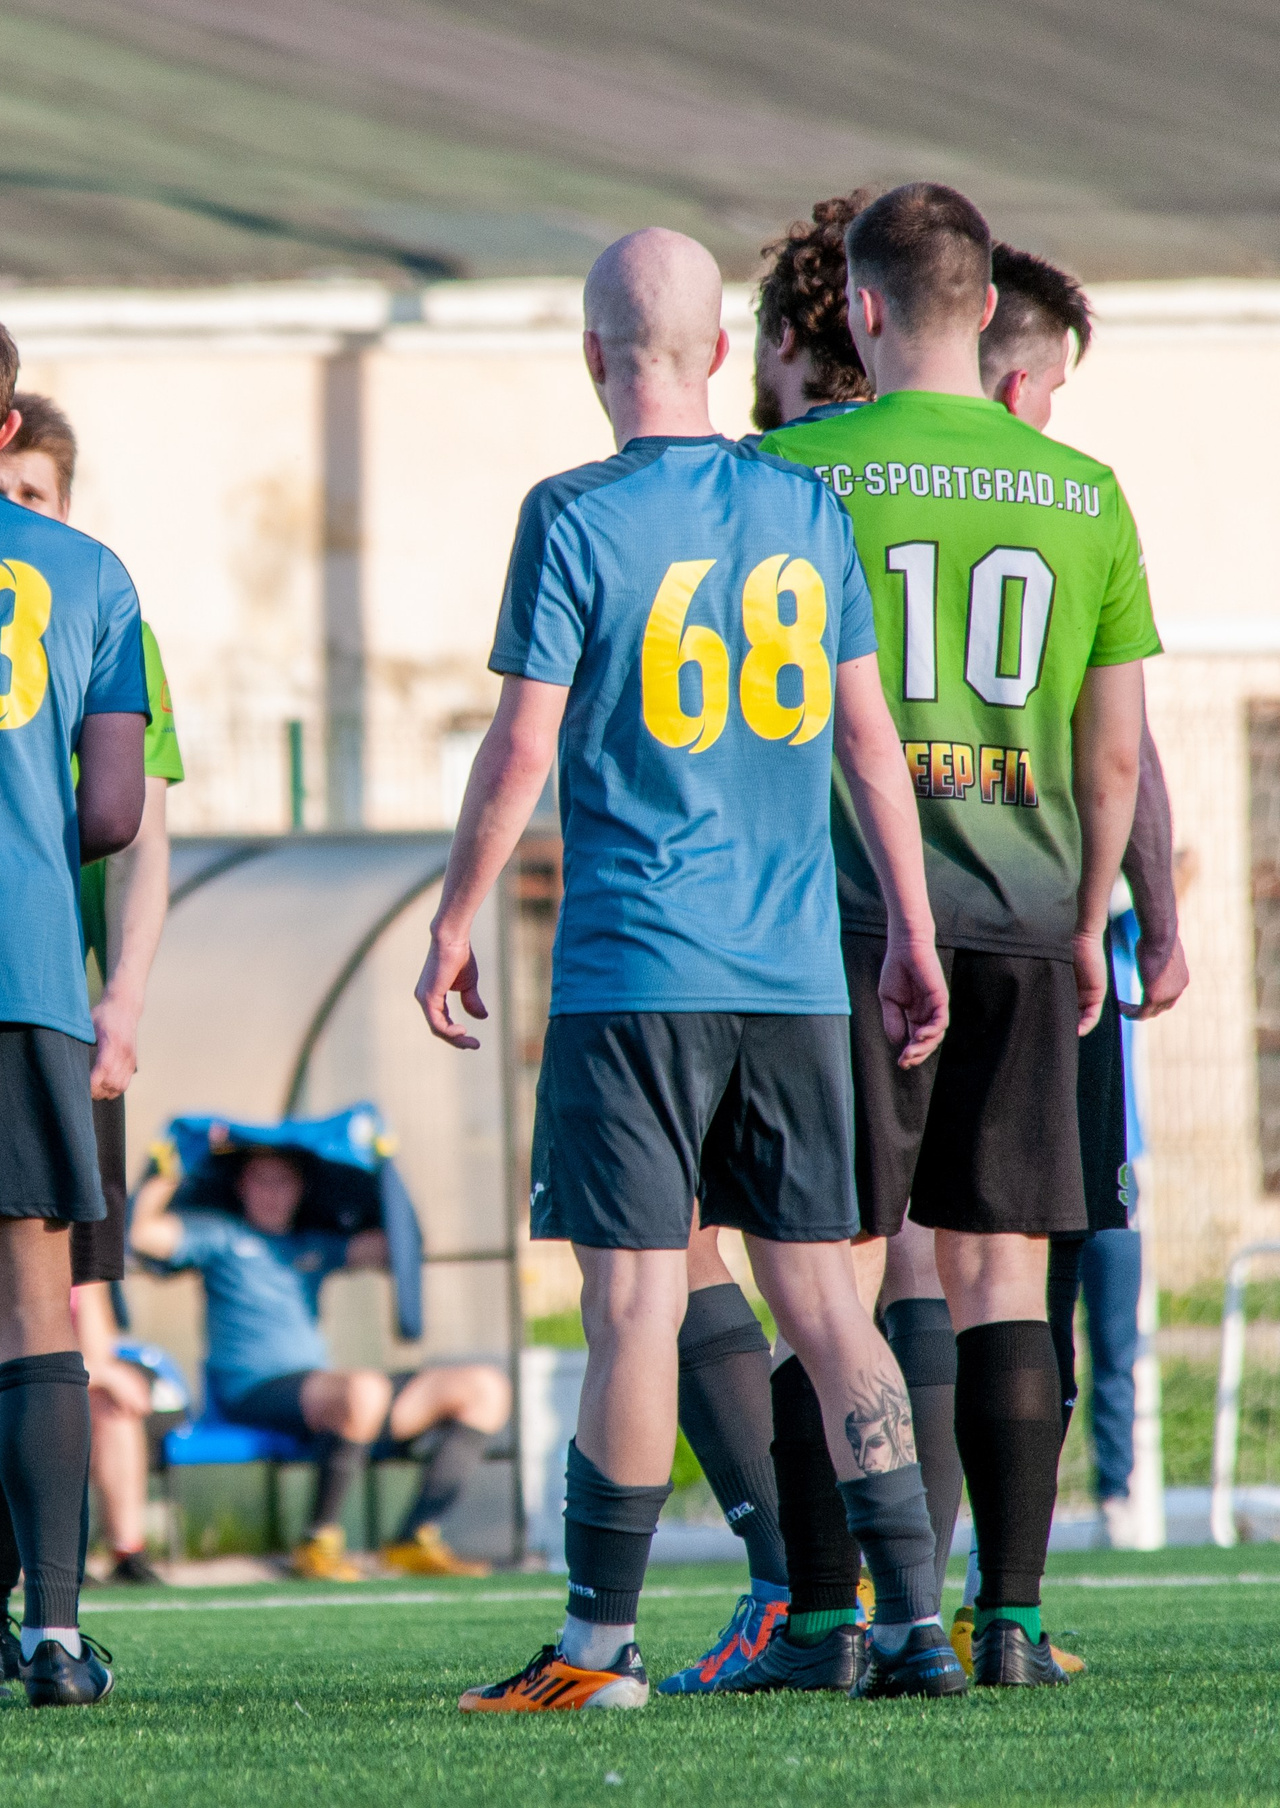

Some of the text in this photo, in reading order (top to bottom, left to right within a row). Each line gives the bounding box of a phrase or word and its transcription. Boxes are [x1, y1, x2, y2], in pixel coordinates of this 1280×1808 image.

[641, 553, 832, 754] 68
[885, 540, 1057, 709] 10
[901, 740, 975, 800] EEP
